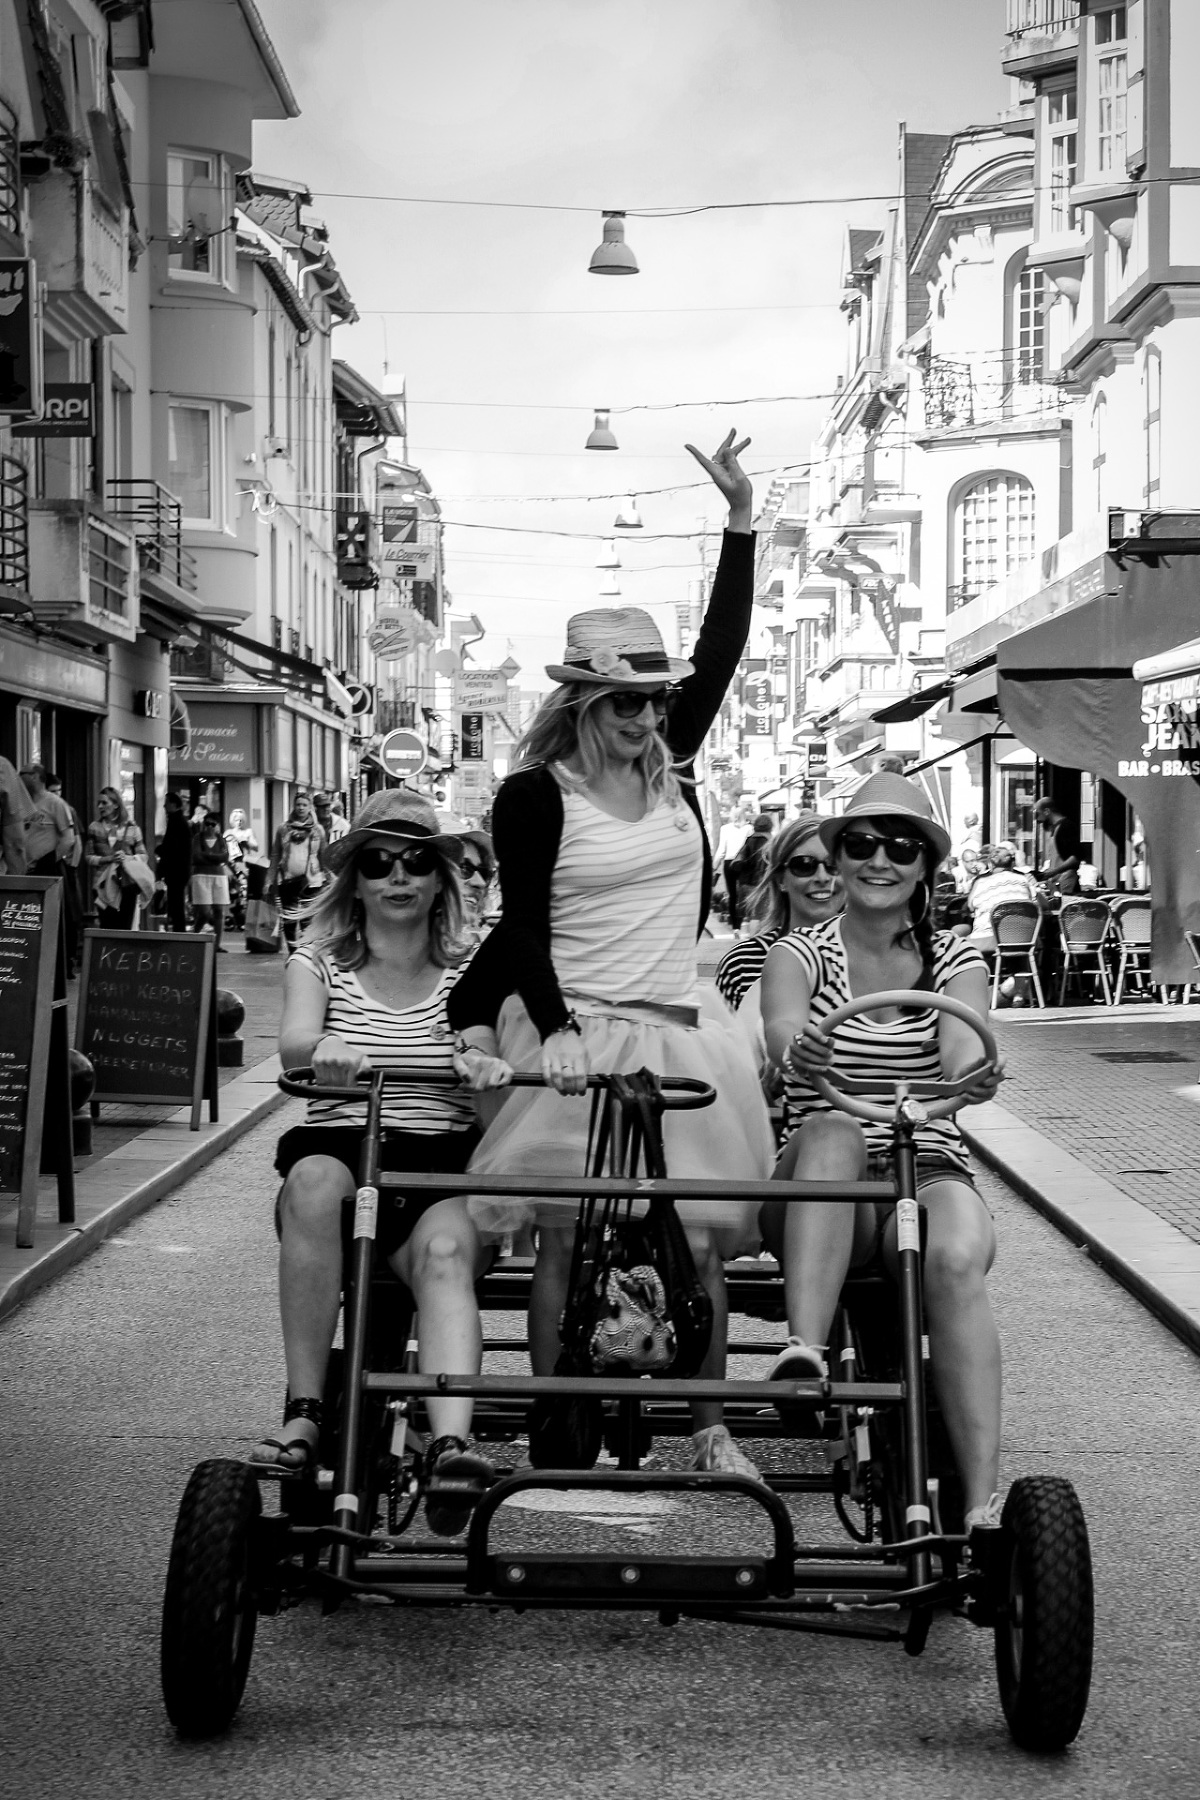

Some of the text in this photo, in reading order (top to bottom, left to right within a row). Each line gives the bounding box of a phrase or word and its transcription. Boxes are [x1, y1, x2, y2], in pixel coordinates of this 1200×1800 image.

[40, 398, 89, 418] RPI
[193, 742, 245, 762] Saisons
[1117, 760, 1150, 777] BAR
[99, 946, 196, 973] KEBAB
